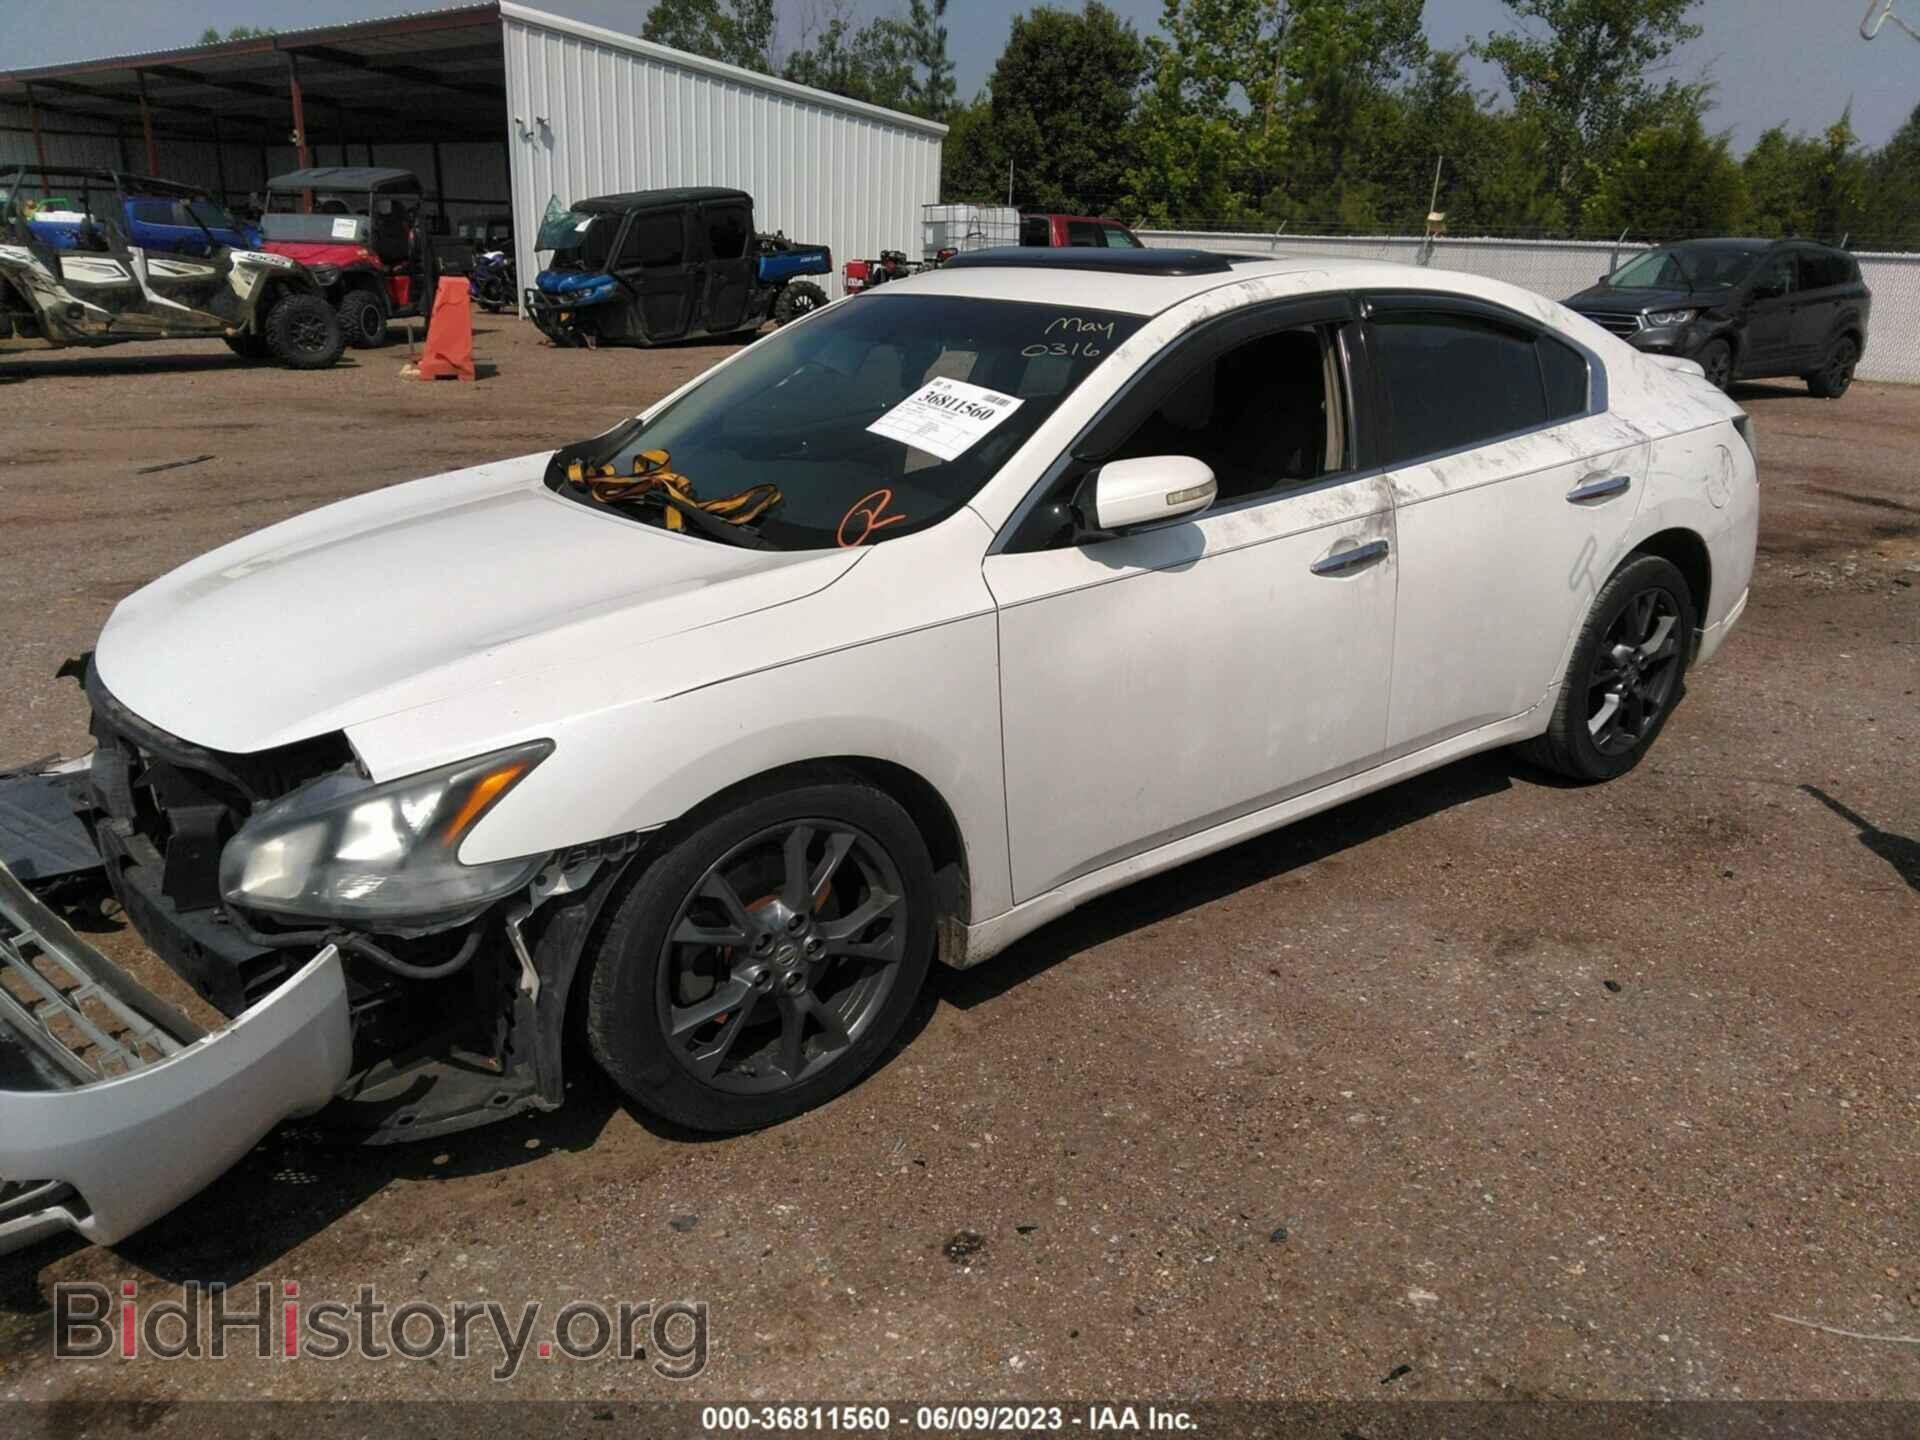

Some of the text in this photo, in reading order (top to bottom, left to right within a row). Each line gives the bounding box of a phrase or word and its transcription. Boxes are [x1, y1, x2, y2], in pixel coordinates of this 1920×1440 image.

[1044, 316, 1114, 340] May
[1021, 341, 1101, 357] 0316
[918, 390, 996, 421] 36811560
